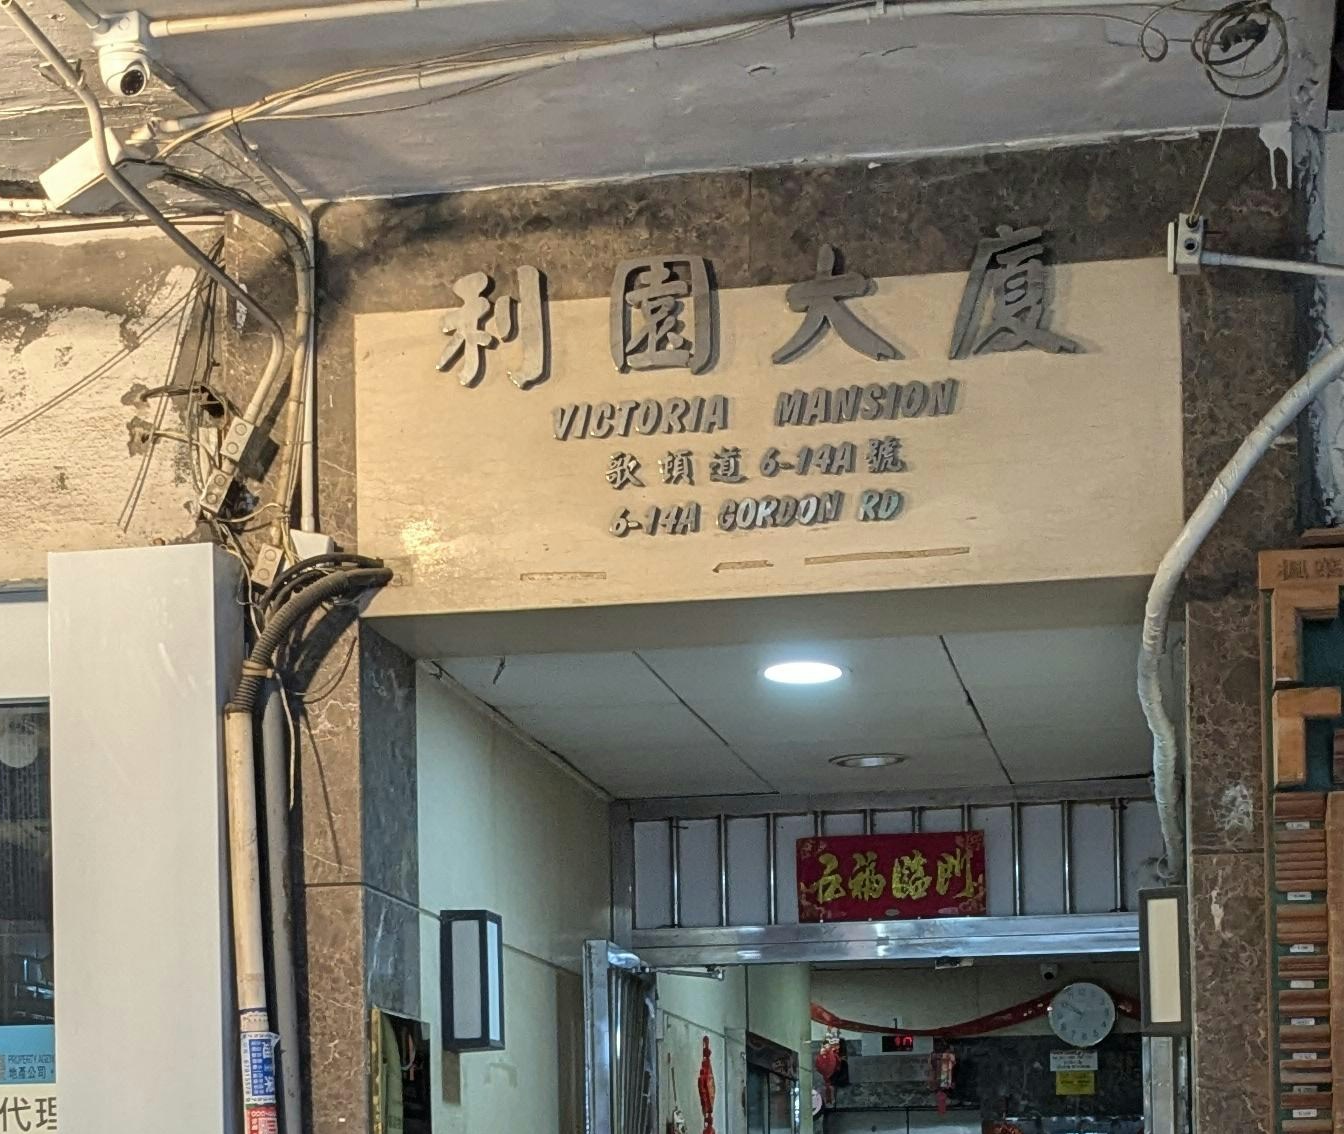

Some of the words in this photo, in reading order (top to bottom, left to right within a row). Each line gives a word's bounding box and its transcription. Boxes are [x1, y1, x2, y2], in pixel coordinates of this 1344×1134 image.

[435, 224, 1086, 391] 利園大廈
[553, 395, 729, 441] VICTORIA
[774, 379, 957, 427] MANSION
[609, 501, 701, 538] 6-14A
[716, 490, 845, 532] GORDON
[857, 489, 903, 522] RD
